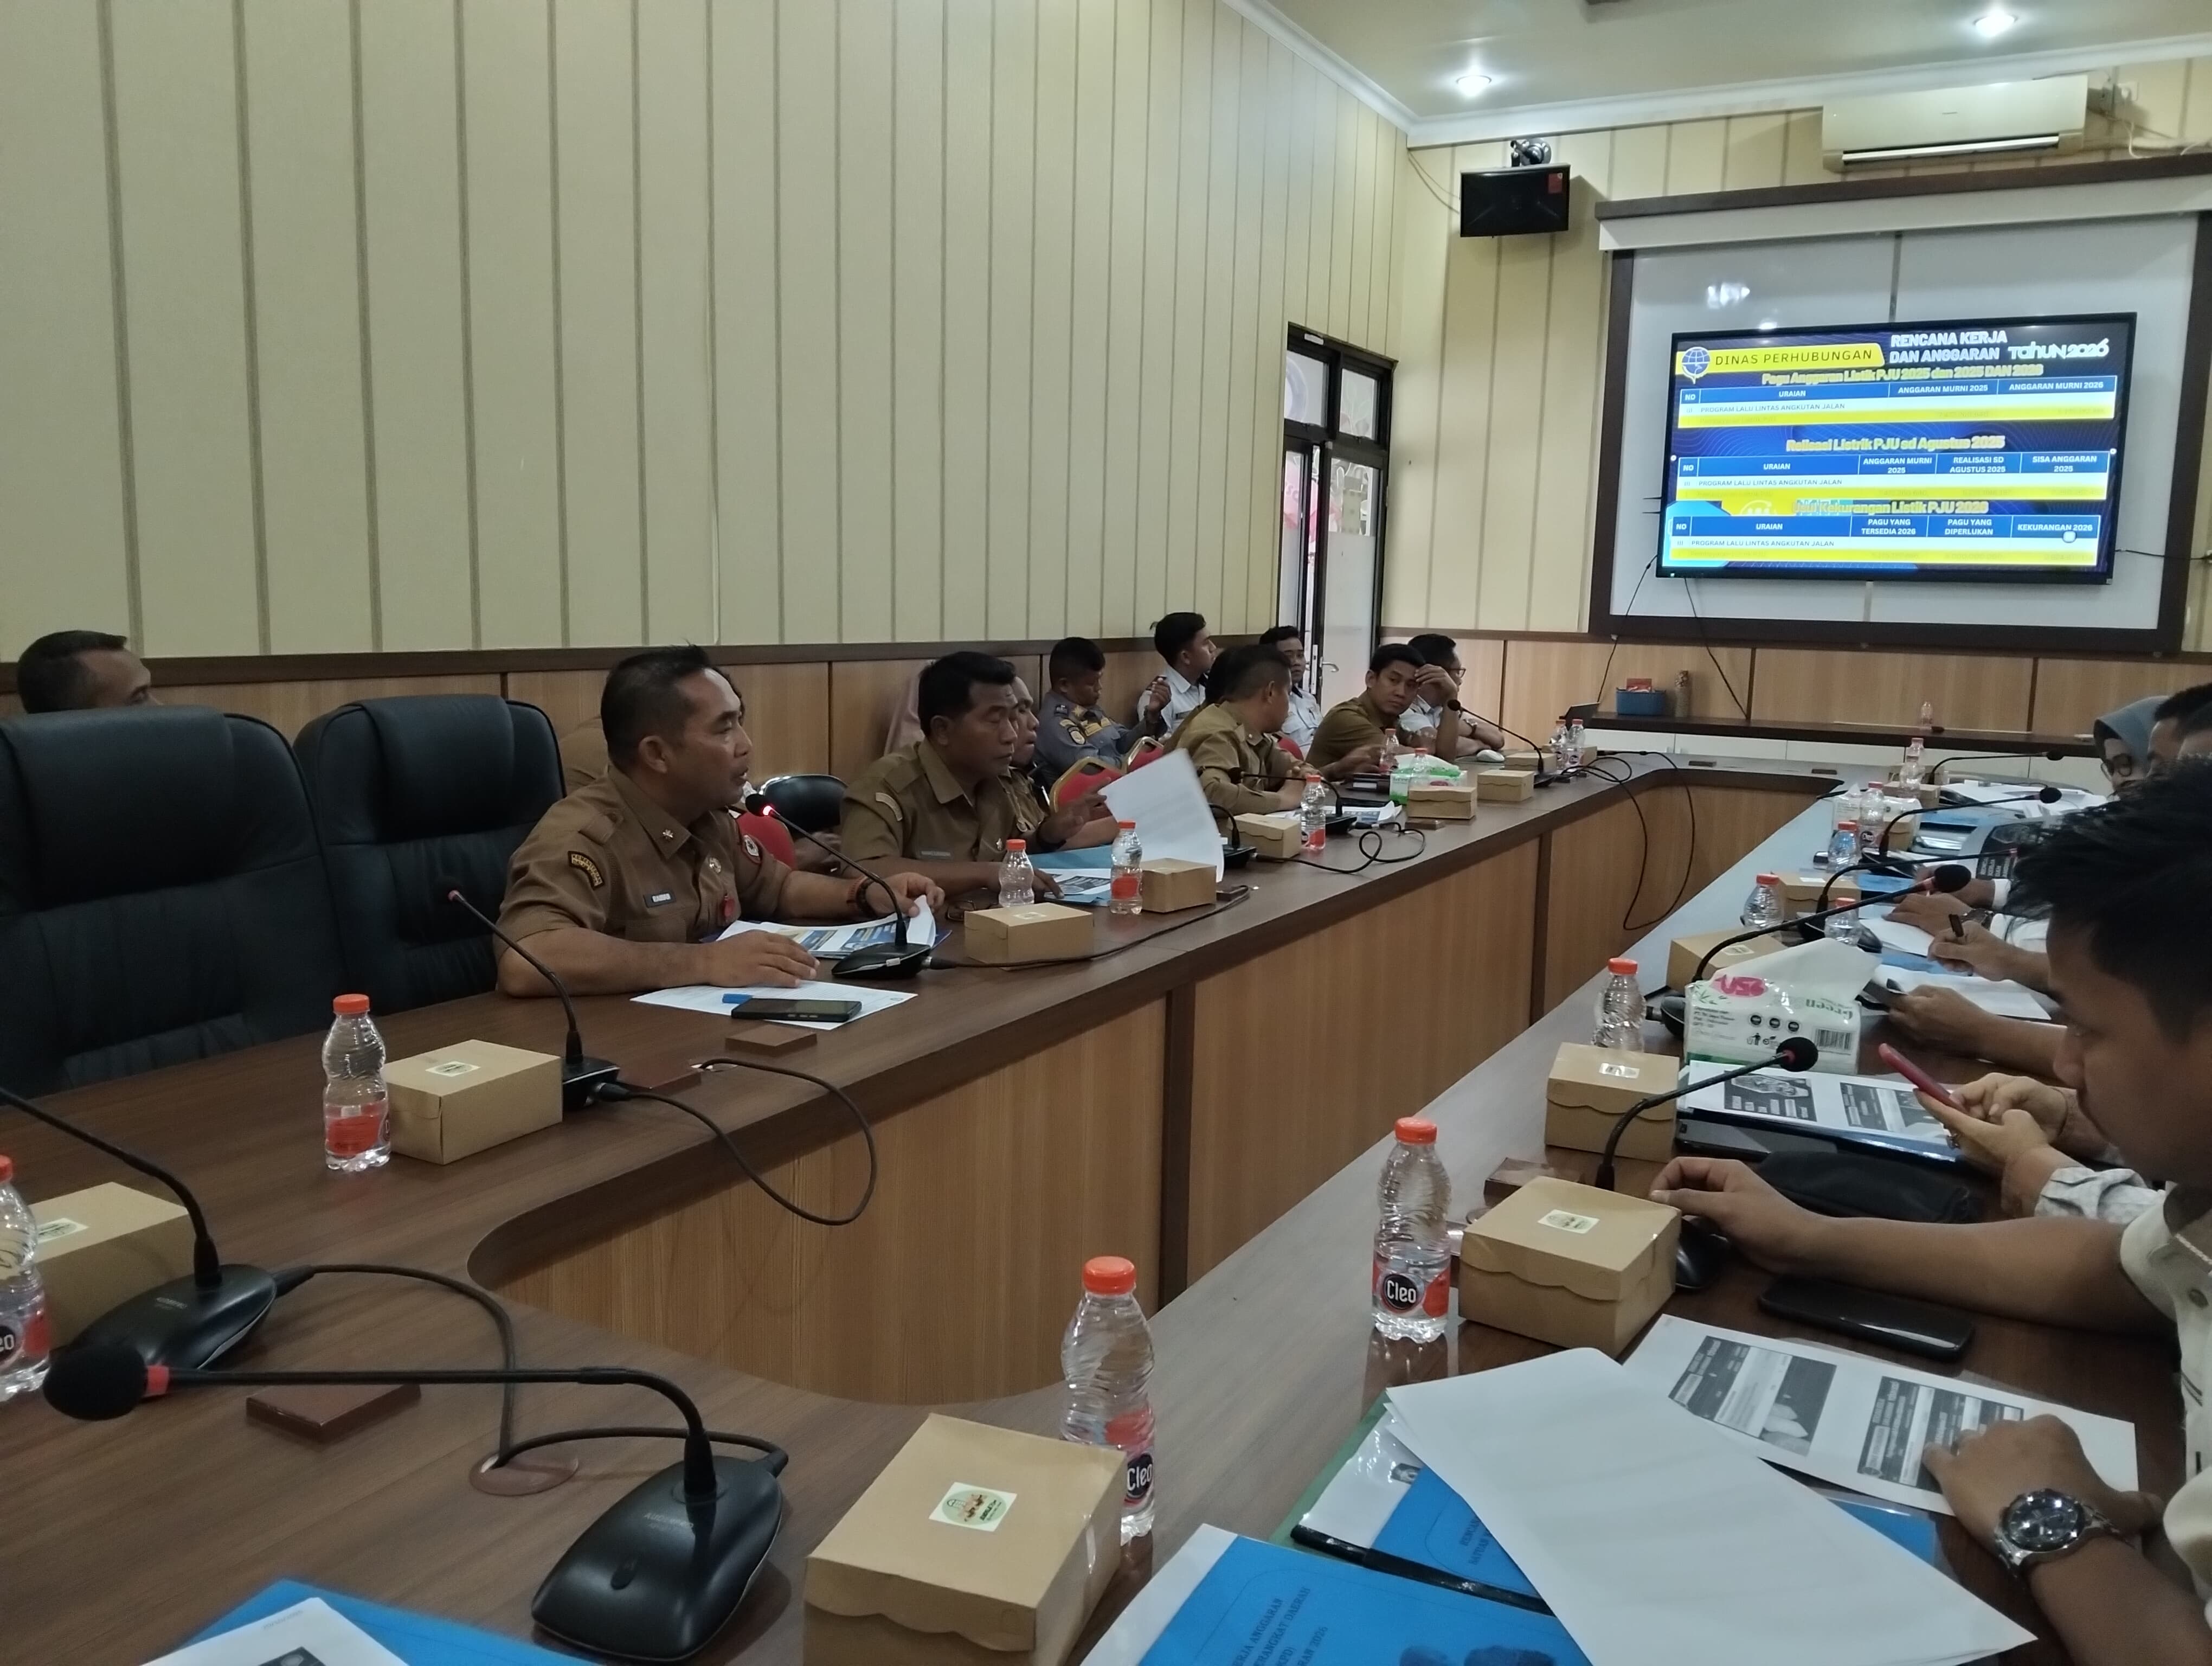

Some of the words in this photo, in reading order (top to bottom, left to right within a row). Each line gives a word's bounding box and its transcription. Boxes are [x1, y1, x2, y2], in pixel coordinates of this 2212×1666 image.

[1891, 332, 1958, 347] RENCANA
[1959, 330, 2008, 345] KERJA
[1715, 352, 1758, 366] DINAS
[1764, 349, 1873, 363] PERHUBUNGAN
[1889, 350, 1919, 363] DAN
[1921, 347, 2000, 362] ANGGARAN
[1876, 368, 1900, 381] PJU
[1984, 364, 2011, 377] DAN
[1898, 386, 1941, 394] ANGGARAN
[1873, 438, 1900, 450] PJU
[1917, 437, 1971, 451] Agustus
[1863, 457, 1905, 465] ANGGARAN
[2051, 455, 2097, 463] ANGGARAN
[1818, 501, 1891, 515] Kekurangan
[1927, 501, 1955, 514] PJU
[1945, 528, 1994, 536] DIPERLUKAN
[2017, 523, 2072, 531] KEKURANGAN
[1387, 1280, 1417, 1303] Cleo
[1127, 1464, 1153, 1491] Cleo
[1283, 1586, 1310, 1621] DAERAH
[1249, 1598, 1283, 1644] ANGGARAN
